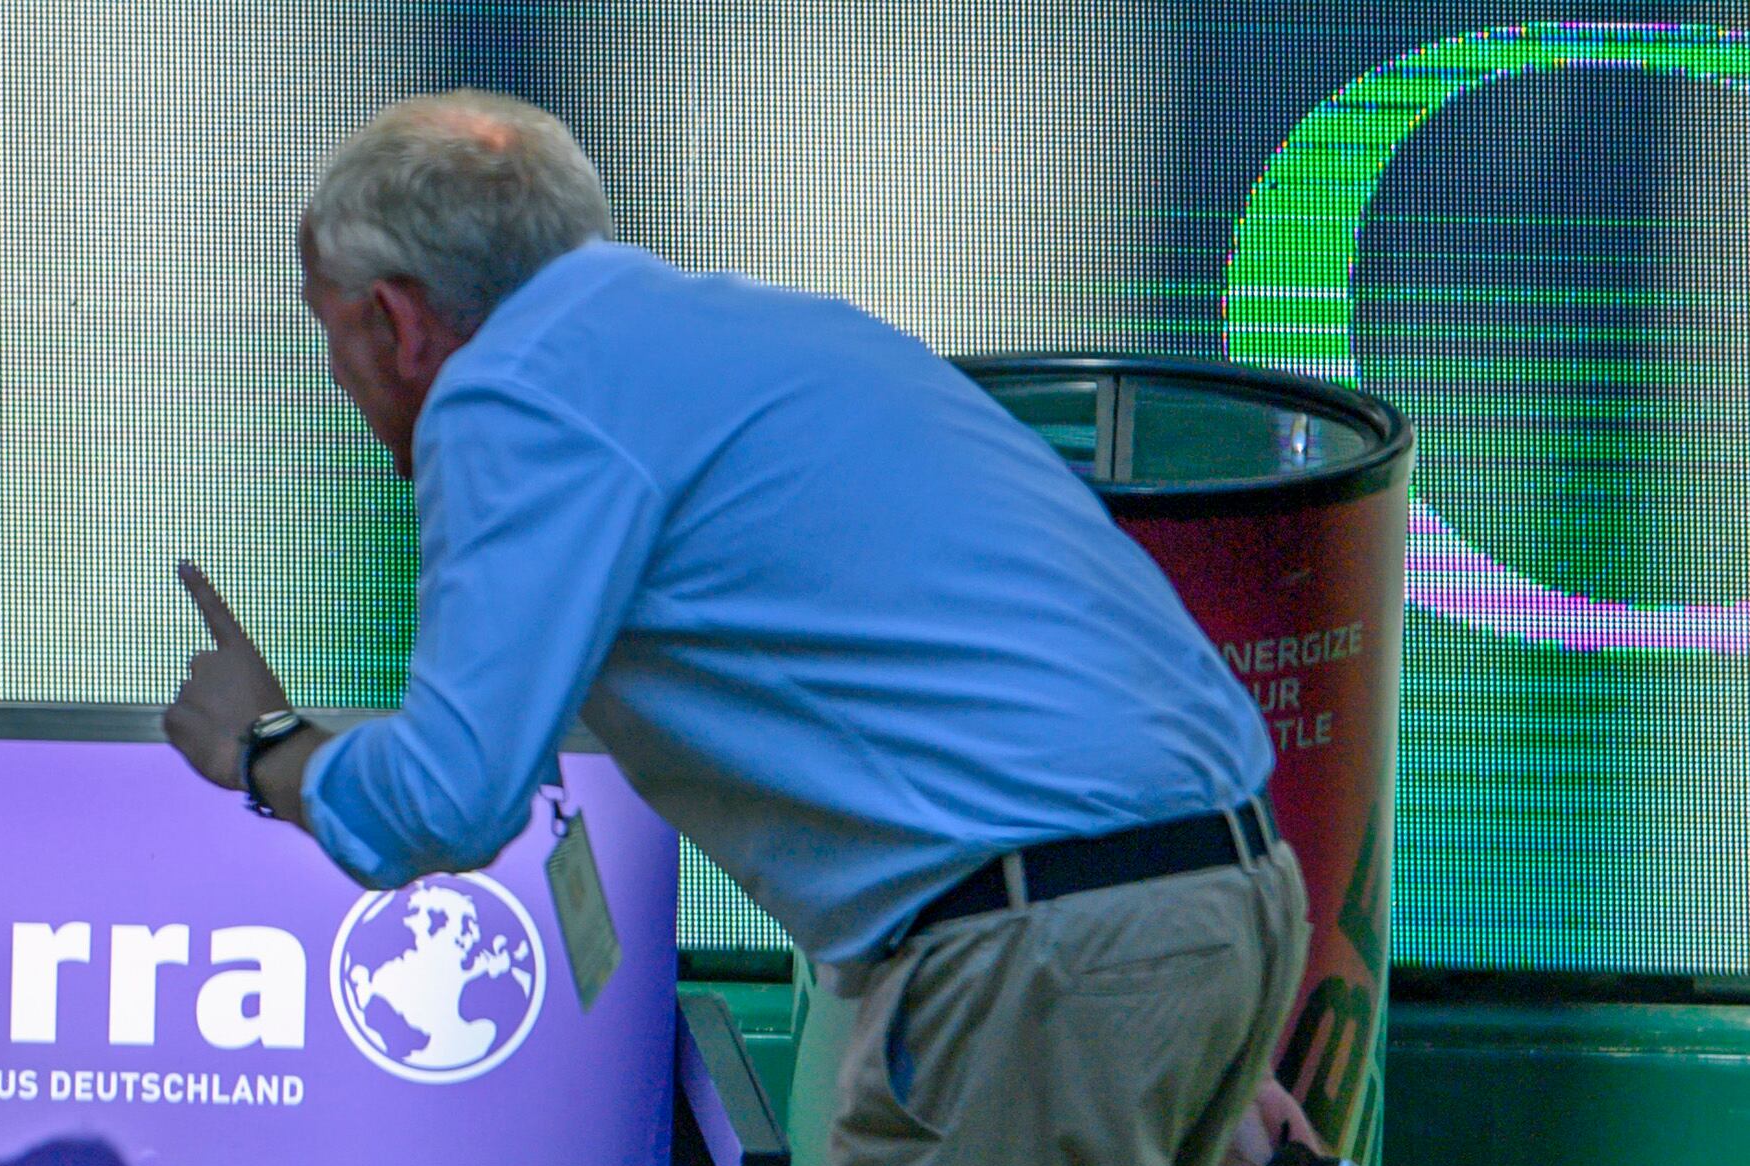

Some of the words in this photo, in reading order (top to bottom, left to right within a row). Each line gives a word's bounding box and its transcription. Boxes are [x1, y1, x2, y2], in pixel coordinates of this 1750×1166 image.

[1222, 622, 1363, 674] NERGIZE
[1253, 677, 1300, 712] UR
[1274, 711, 1333, 750] TLE
[50, 1070, 305, 1106] DEUTSCHLAND
